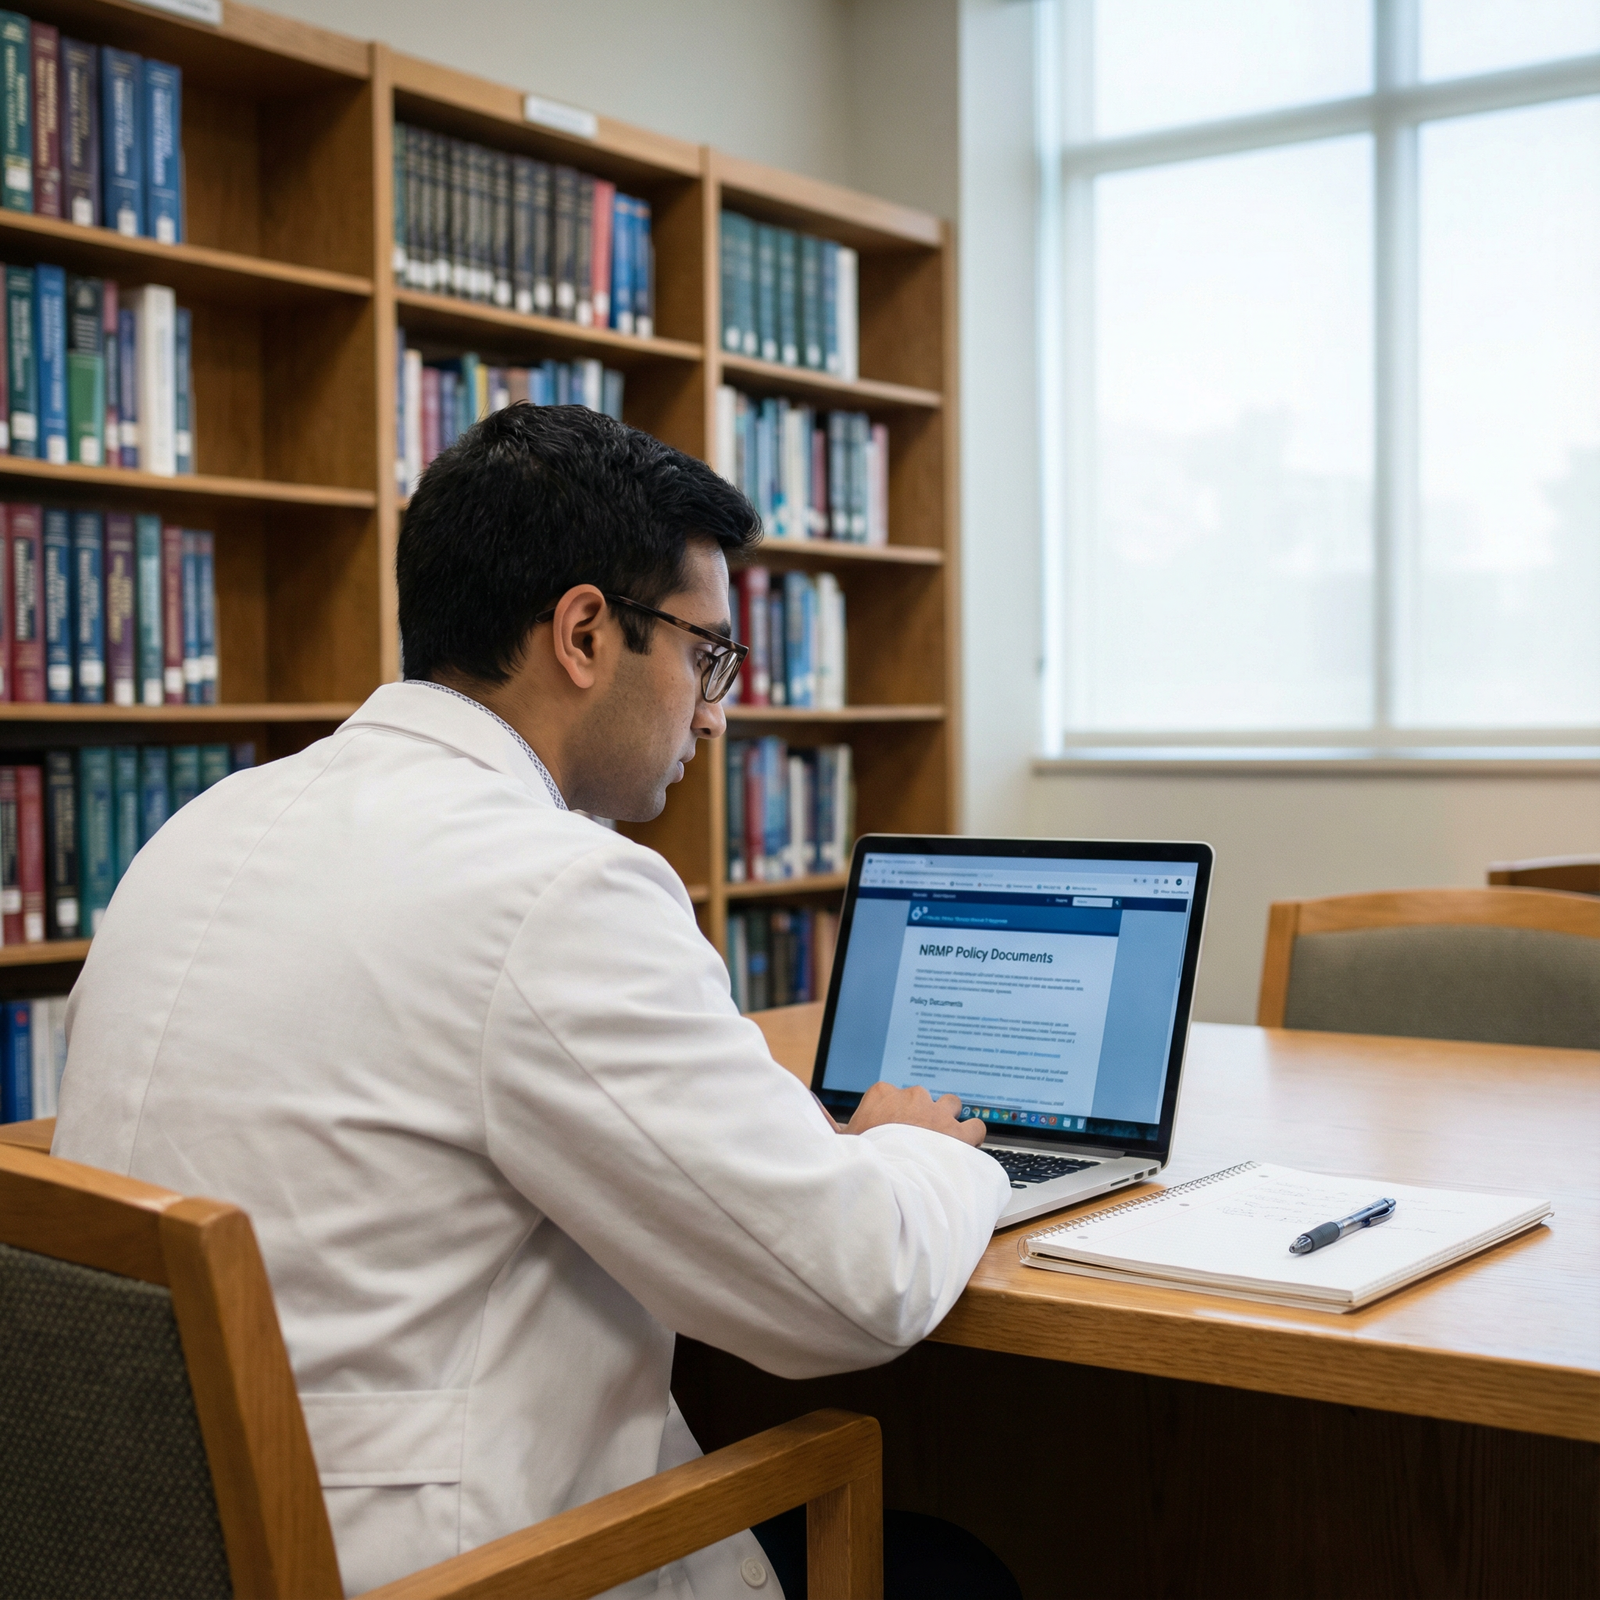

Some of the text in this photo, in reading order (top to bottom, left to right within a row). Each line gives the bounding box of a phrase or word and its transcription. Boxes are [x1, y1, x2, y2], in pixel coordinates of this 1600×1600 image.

[919, 944, 1053, 963] NRMP Policy Documents
